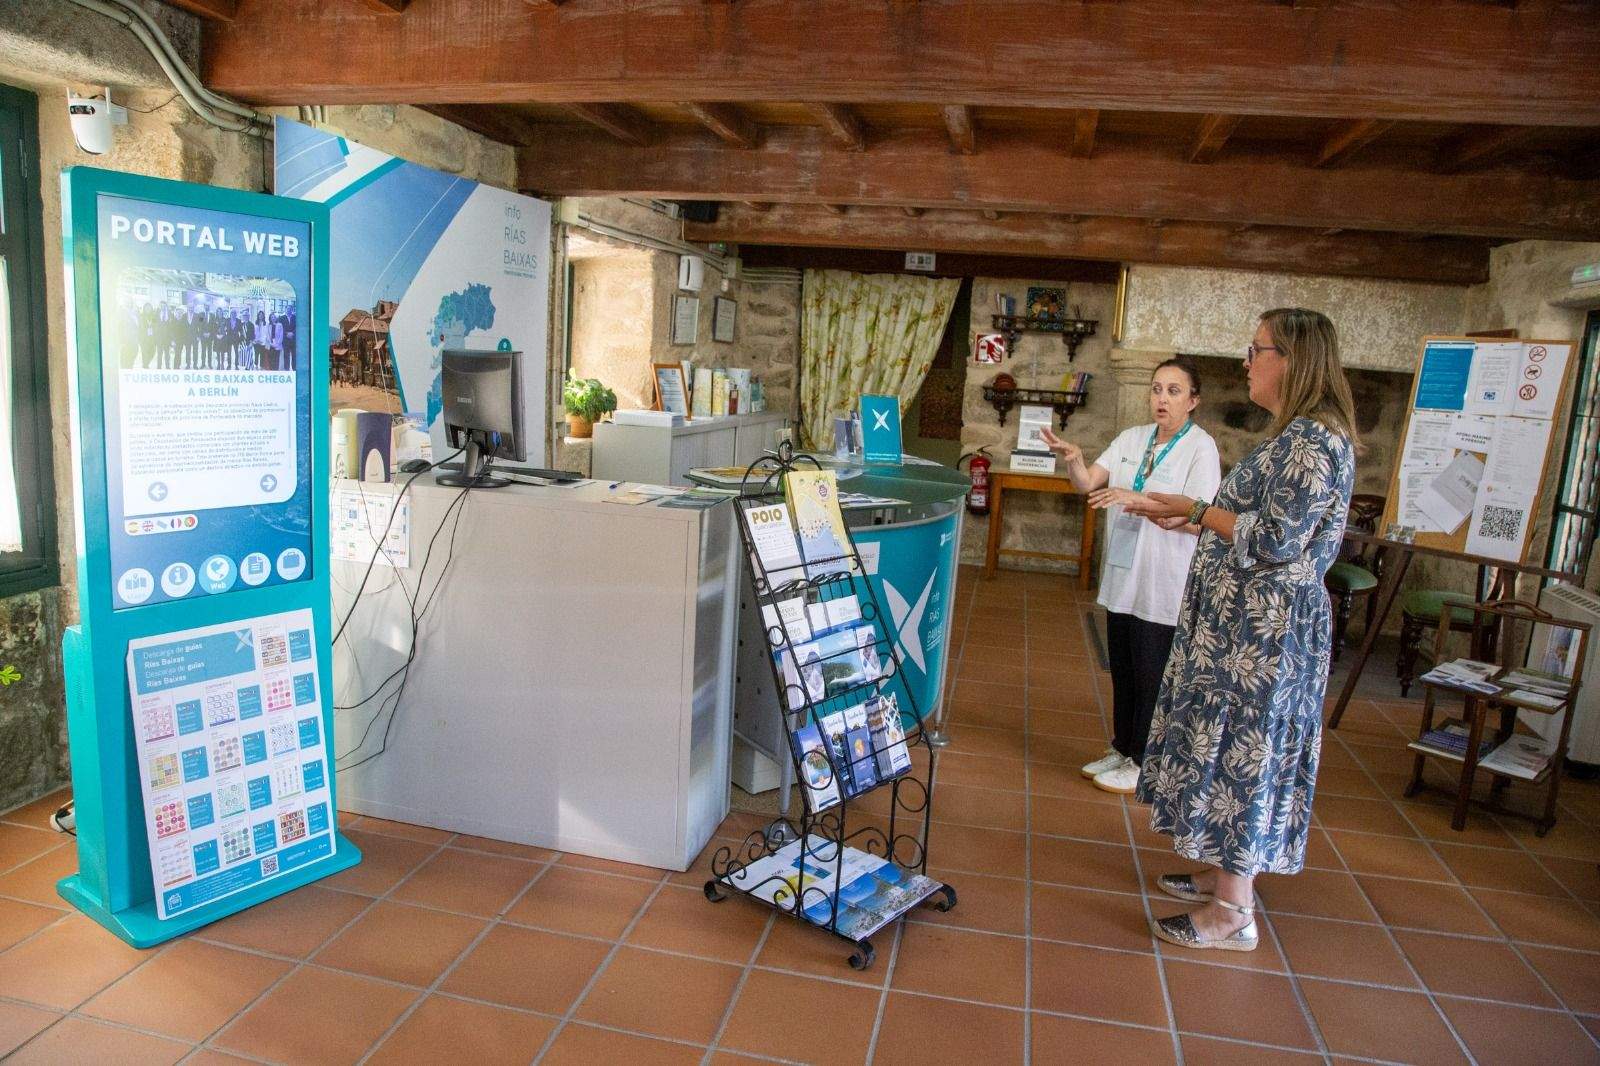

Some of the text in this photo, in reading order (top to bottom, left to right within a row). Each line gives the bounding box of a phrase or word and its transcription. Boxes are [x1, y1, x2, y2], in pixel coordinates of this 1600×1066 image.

[505, 202, 521, 220] info
[110, 215, 299, 258] PORTAL WEB
[504, 226, 526, 244] RÍAS
[504, 250, 537, 269] BAIXAS
[124, 372, 292, 384] TURISMO RÍAS BAIXAS CHEGA
[188, 386, 239, 397] A BERLÍN
[752, 508, 782, 524] POIO
[210, 582, 226, 590] Web
